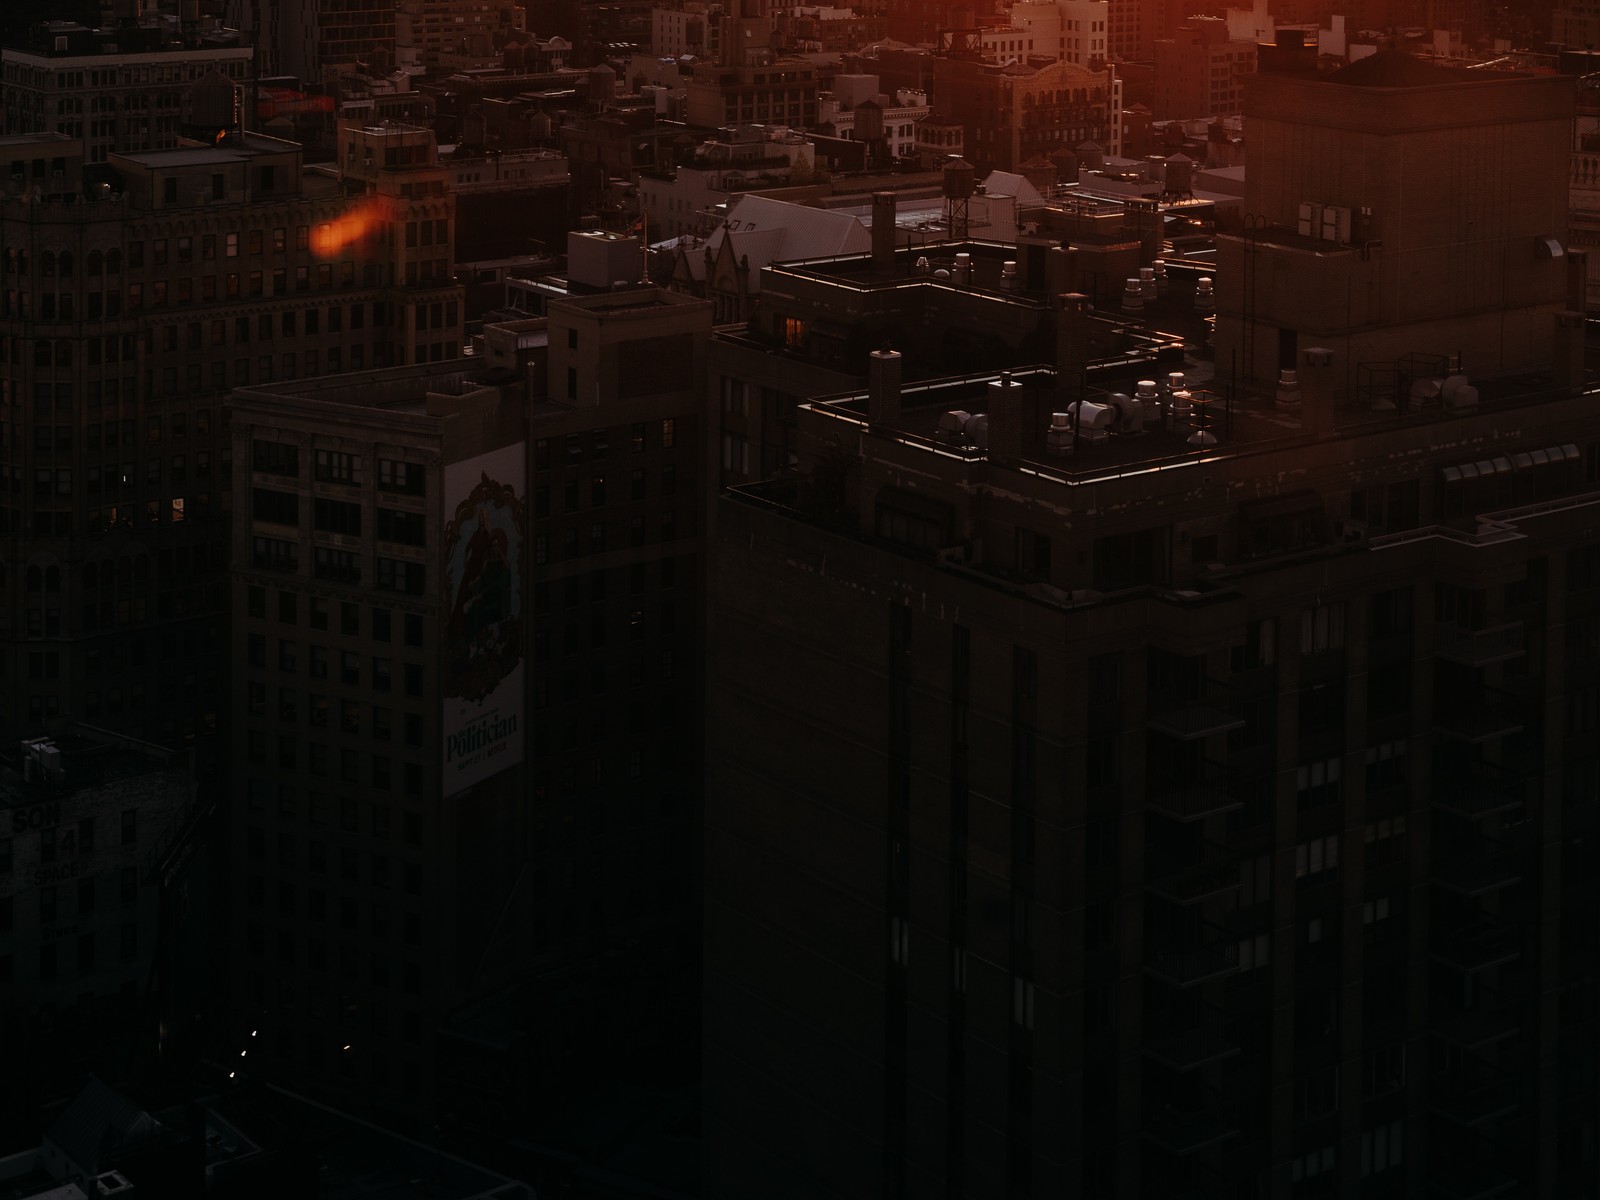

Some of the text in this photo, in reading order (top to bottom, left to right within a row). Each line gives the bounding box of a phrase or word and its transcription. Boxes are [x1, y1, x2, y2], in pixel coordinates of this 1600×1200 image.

[447, 714, 517, 762] Politician
[12, 802, 61, 833] SON
[34, 861, 79, 886] SPACE
